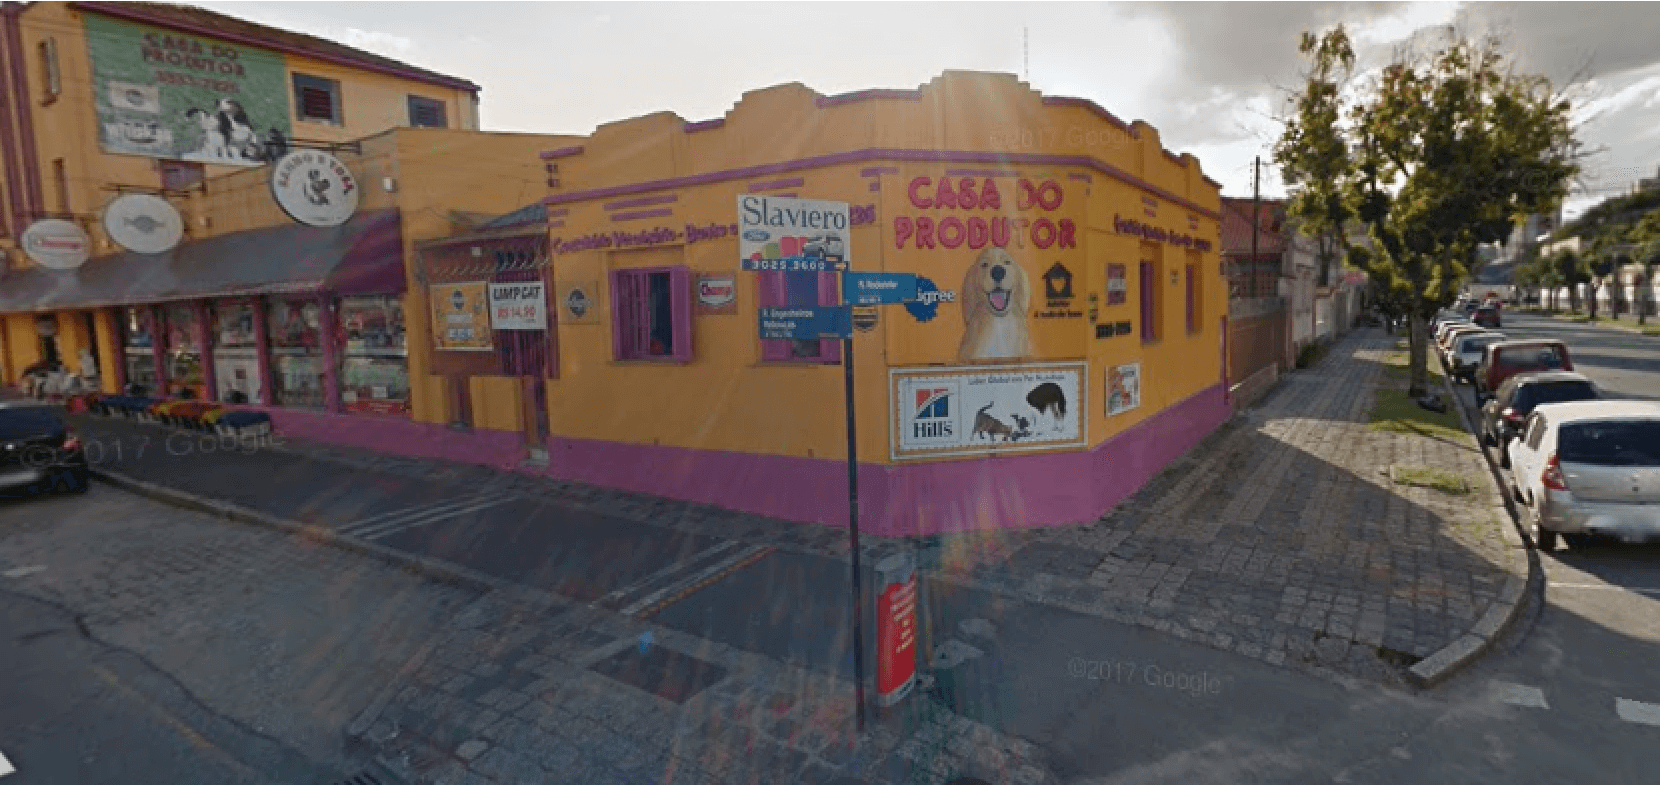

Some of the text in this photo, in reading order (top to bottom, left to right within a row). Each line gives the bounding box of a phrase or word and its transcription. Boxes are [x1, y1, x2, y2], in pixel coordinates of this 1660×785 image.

[908, 176, 1065, 212] CASA DO
[743, 196, 847, 230] Slaviero
[894, 216, 1077, 250] PRODUTOR
